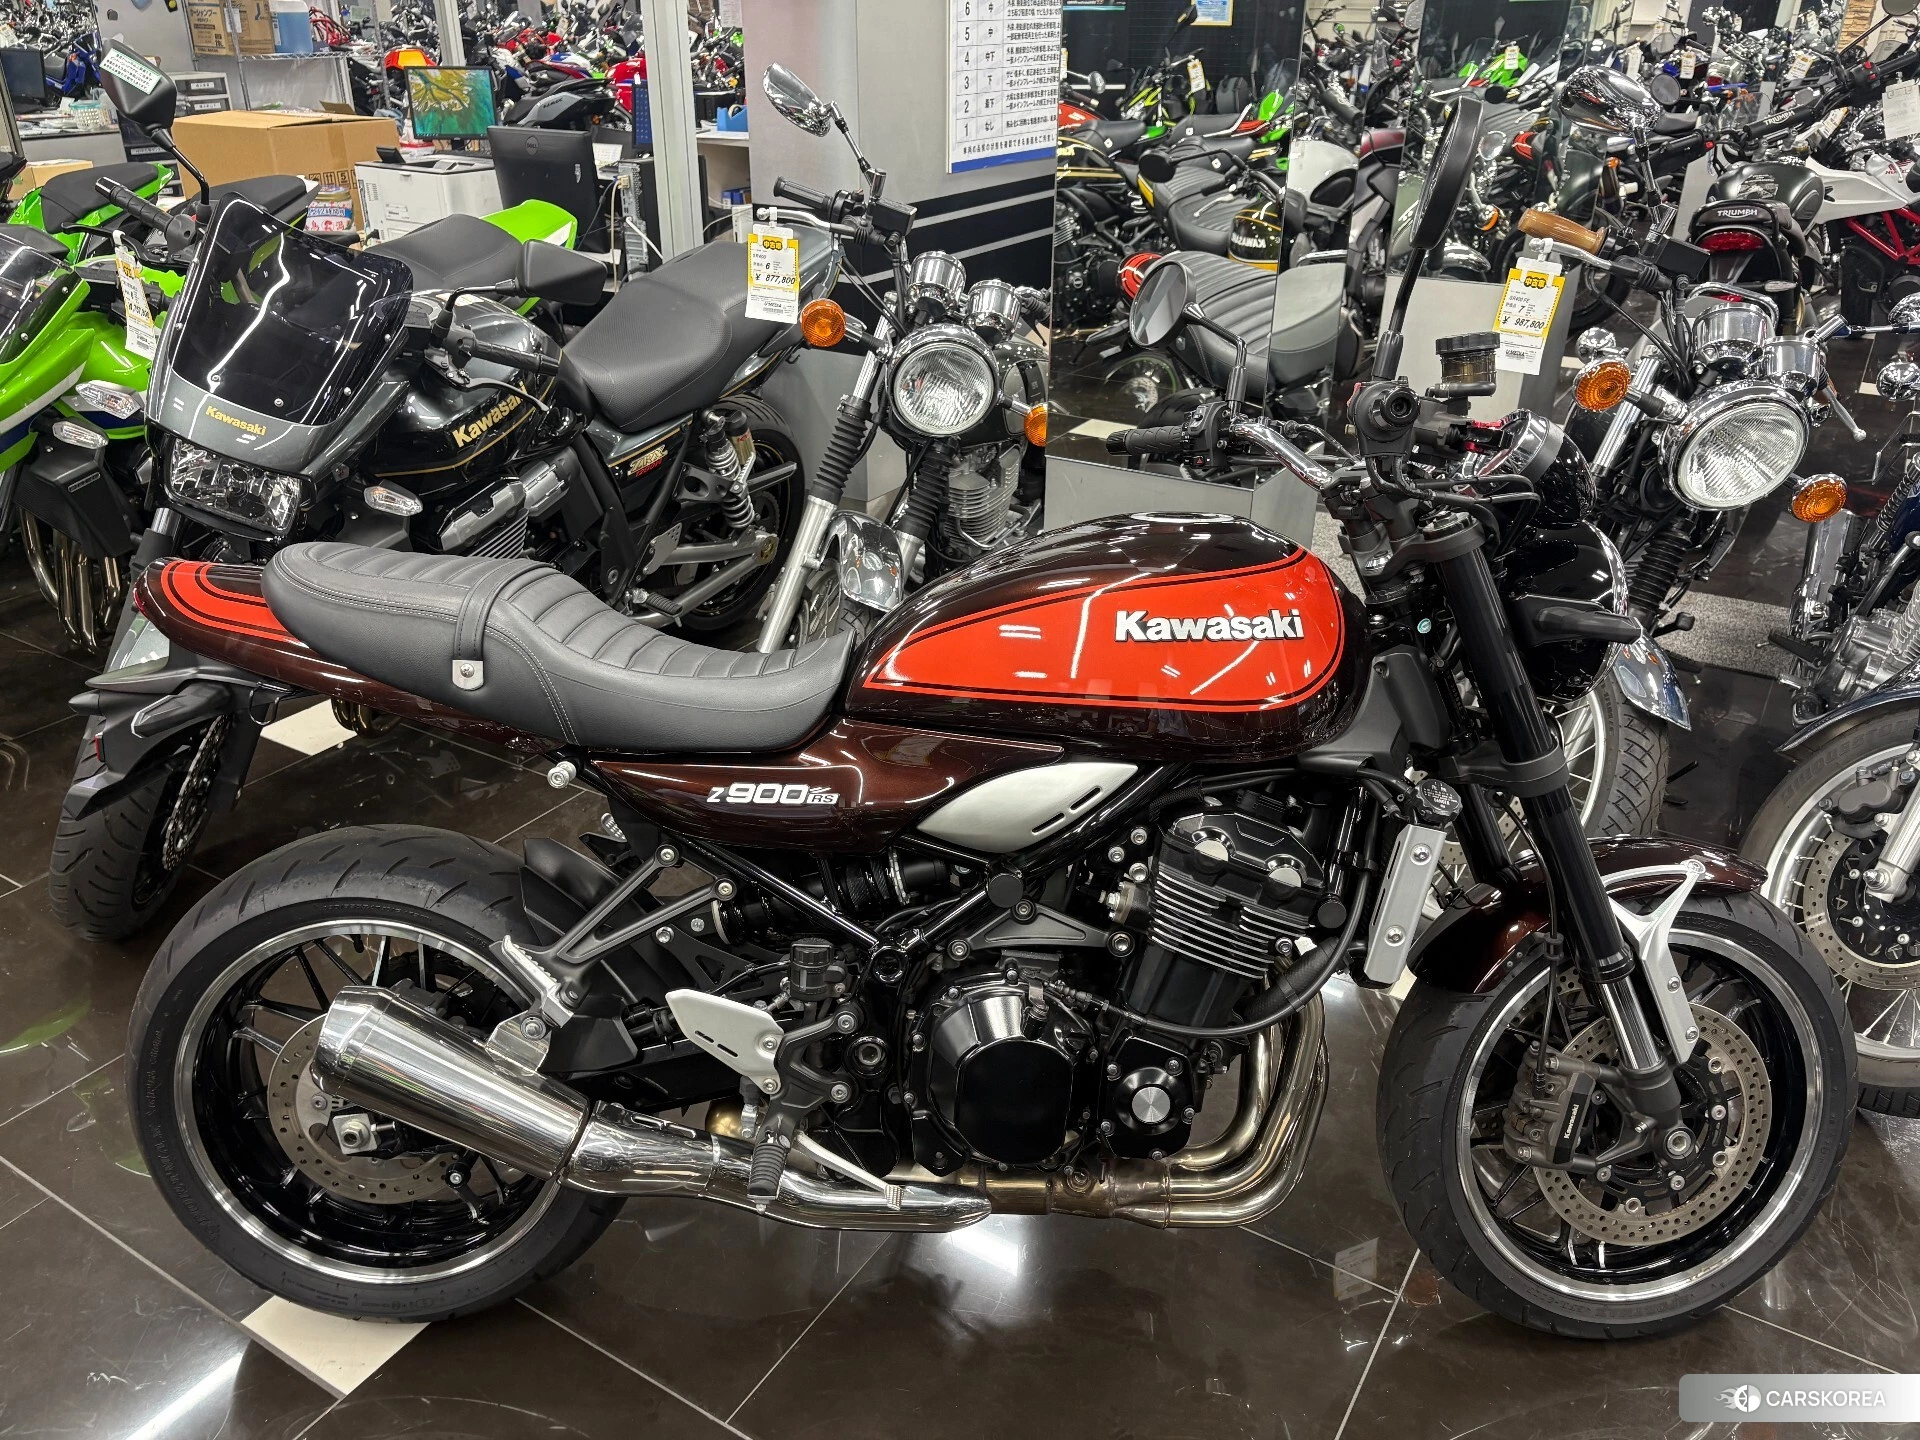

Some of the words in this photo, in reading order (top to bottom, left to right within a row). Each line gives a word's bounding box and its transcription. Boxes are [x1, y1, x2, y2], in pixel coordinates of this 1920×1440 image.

[964, 1, 971, 16] 6
[964, 26, 971, 41] 5
[964, 51, 970, 66] 4
[964, 75, 970, 90] 3
[964, 99, 970, 114] 2
[1763, 109, 1796, 126] TRIUMPH
[964, 122, 969, 137] 1
[1717, 208, 1758, 218] TRIUMPH
[765, 262, 771, 270] 6
[765, 274, 796, 285] 877,800
[1524, 276, 1546, 289] 中古車
[1518, 305, 1526, 313] 7
[1514, 317, 1545, 330] 987,800
[205, 405, 267, 436] Kawasaki
[1115, 609, 1305, 642] Kawasaki
[1564, 1104, 1579, 1139] Kawasaki
